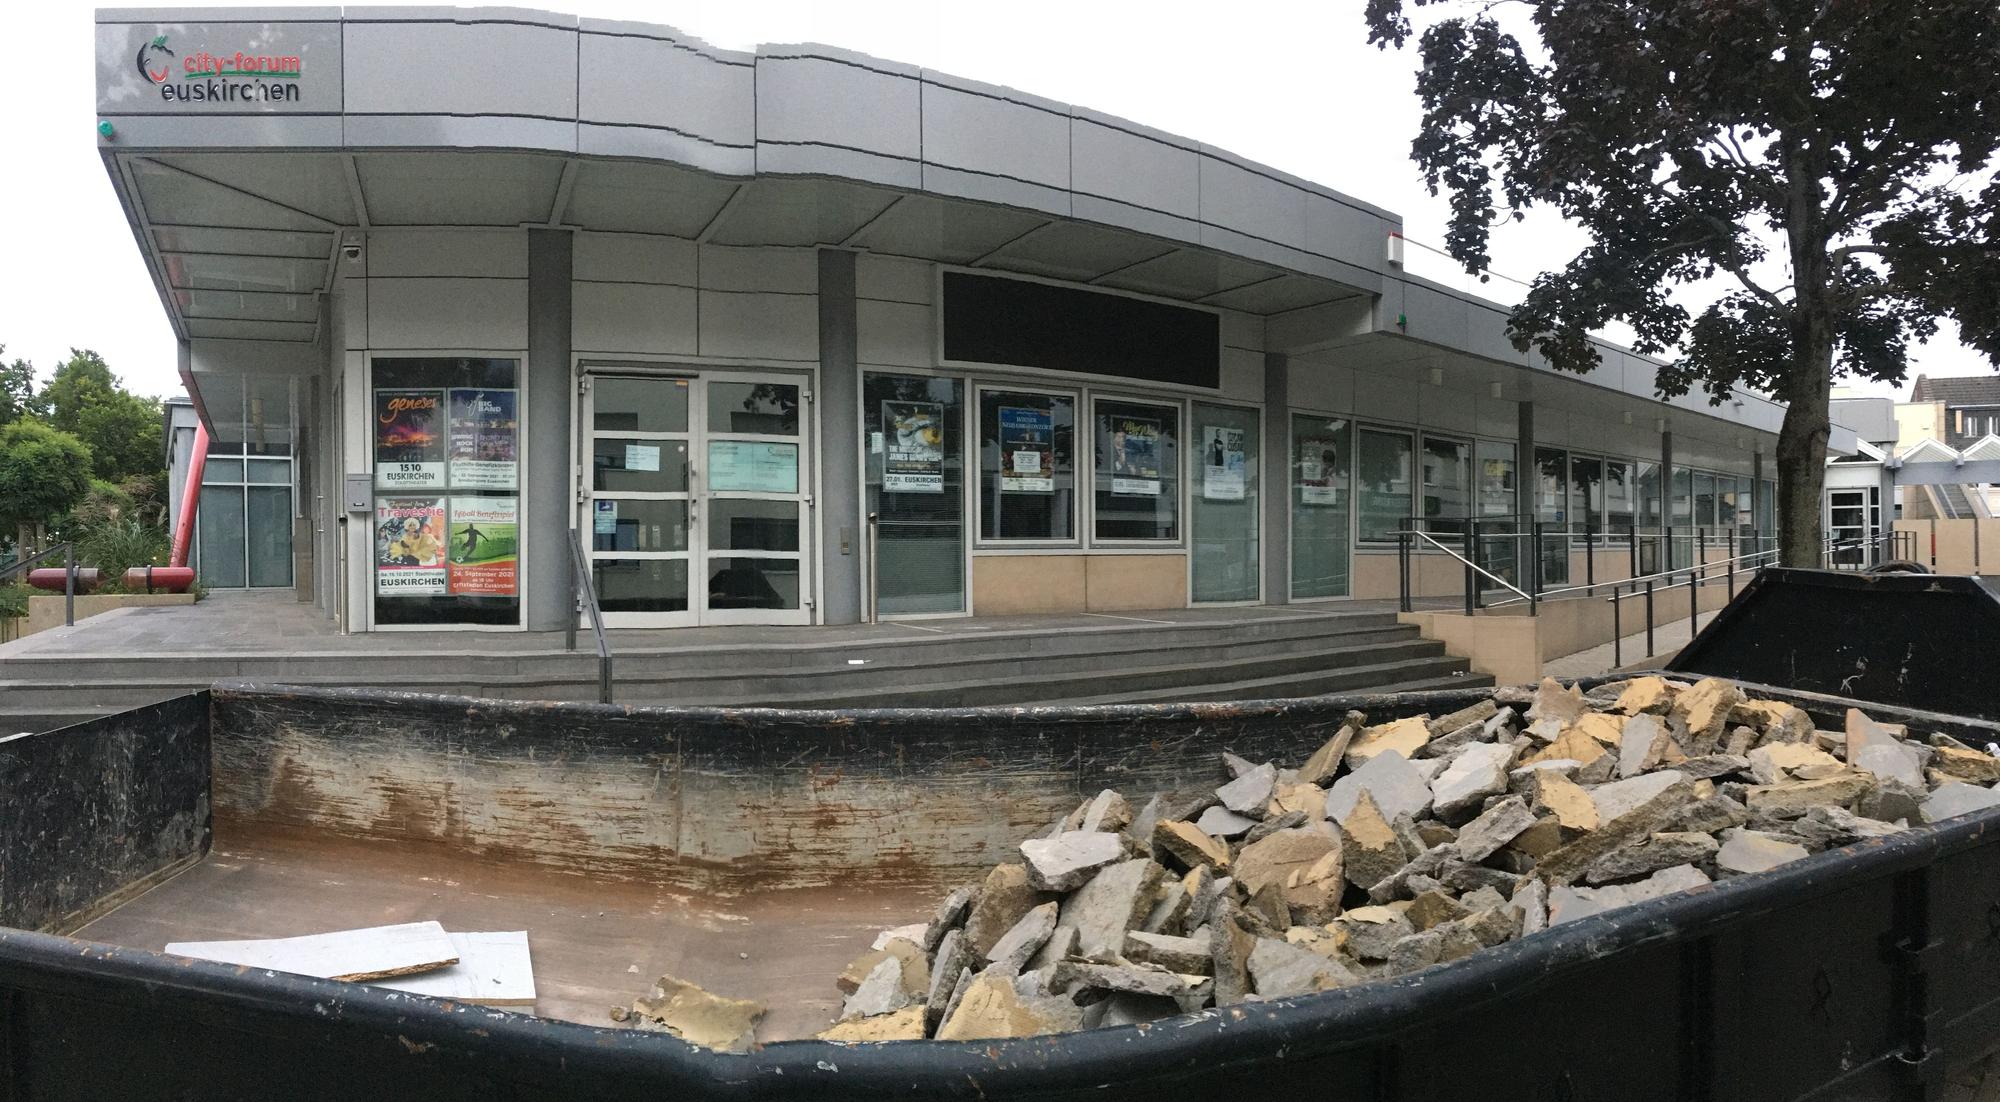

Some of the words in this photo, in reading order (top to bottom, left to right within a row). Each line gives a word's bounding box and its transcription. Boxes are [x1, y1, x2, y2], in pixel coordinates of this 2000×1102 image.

[184, 52, 300, 77] city-forum
[162, 79, 299, 102] euskirchen
[378, 507, 445, 517] Travestie
[381, 578, 445, 586] EUSKIRCHEN
